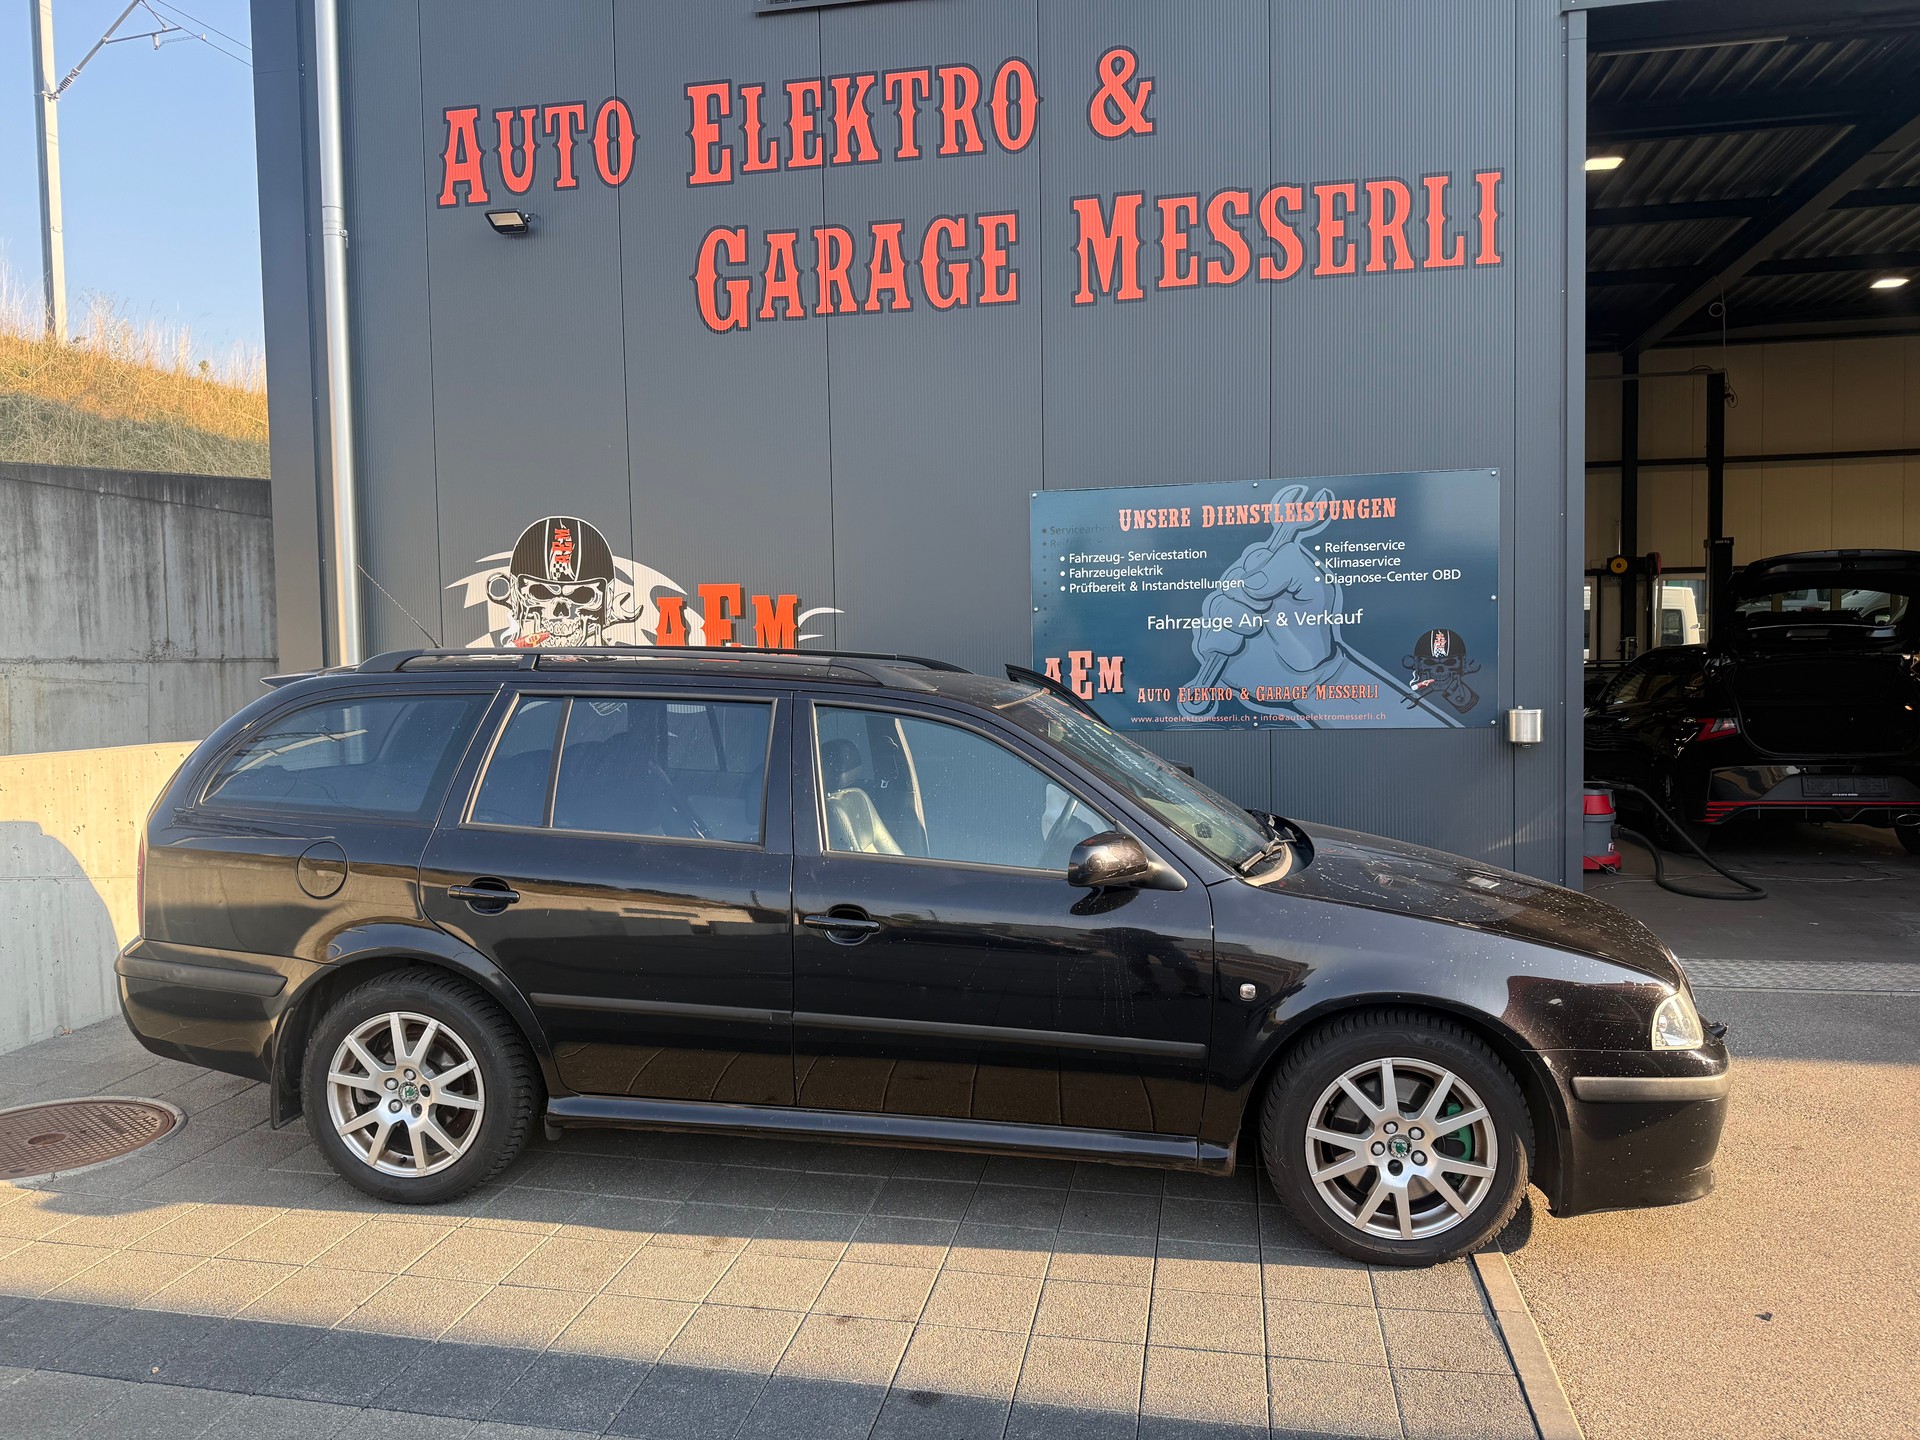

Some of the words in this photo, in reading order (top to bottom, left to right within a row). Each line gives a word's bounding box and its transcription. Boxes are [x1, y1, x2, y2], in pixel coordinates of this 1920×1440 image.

[438, 98, 637, 207] AUTO
[686, 58, 1040, 186] ELEKTRO
[1088, 48, 1154, 139] &
[693, 212, 1018, 333] GARAGE
[1072, 169, 1503, 305] MESSERLI
[1119, 508, 1191, 531] UNSERE
[1202, 497, 1397, 528] DIENSTLEISTUNGEN
[1325, 540, 1406, 553] Reifenservice
[1069, 552, 1126, 565] Fahrzeug-
[1128, 549, 1207, 562] Servicestation
[1325, 556, 1401, 568] Klimaservice
[1069, 565, 1163, 579] Fahrzeugelektrik
[1325, 571, 1428, 586] Diagnose-Center
[1432, 569, 1462, 581] OBD
[1069, 580, 1126, 593] Prüfbereit
[1129, 581, 1139, 592] &
[1142, 578, 1245, 591] Instandstellungen
[655, 583, 799, 650] AEM
[1147, 614, 1233, 632] Fahrzeuge
[1238, 613, 1270, 628] An-
[1275, 611, 1289, 627] &
[1294, 608, 1364, 626] Verkauf
[1043, 651, 1124, 700] AEM
[1137, 688, 1172, 703] AUTO
[1178, 687, 1233, 703] ELEKTRO
[1239, 687, 1250, 701] &
[1255, 685, 1308, 702] GARAGE
[1315, 684, 1379, 700] MESSERLI
[1130, 714, 1250, 723] www.autoelektromesserli.ch
[1260, 713, 1386, 722] info@autoelektromesserli.ch
